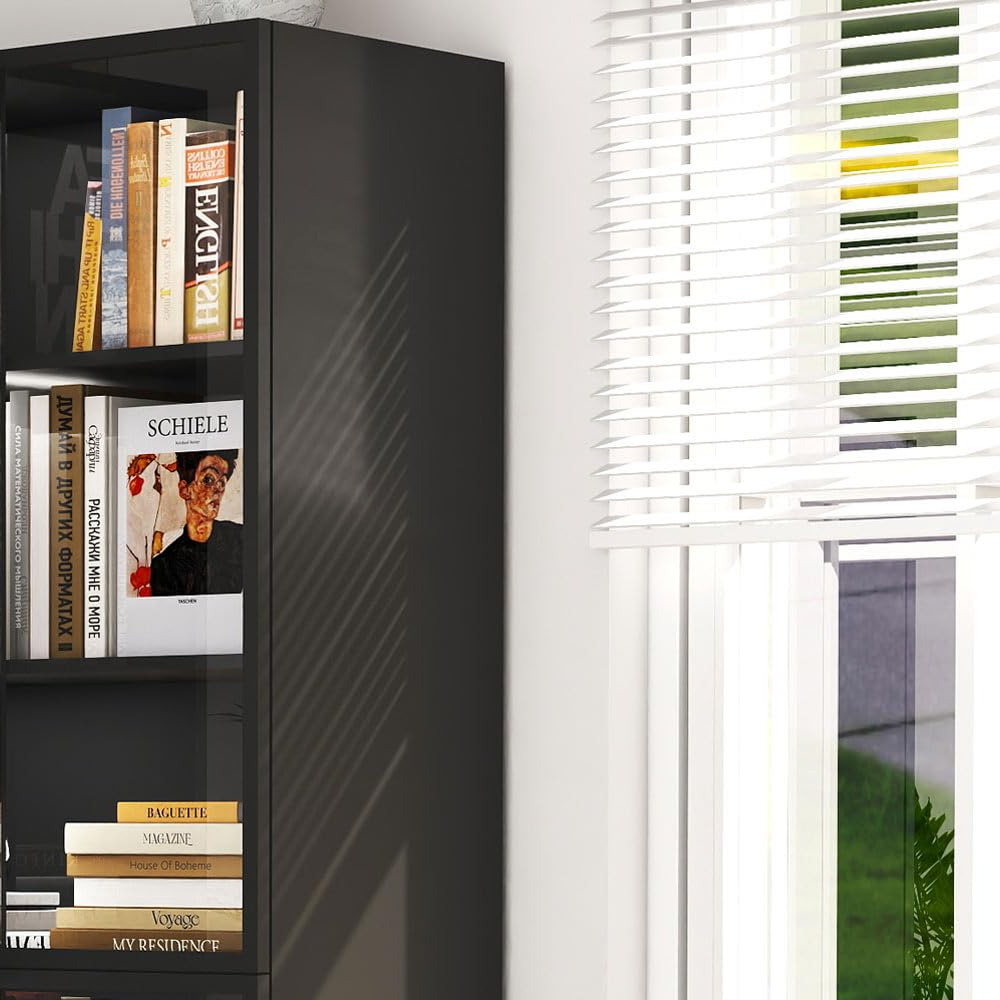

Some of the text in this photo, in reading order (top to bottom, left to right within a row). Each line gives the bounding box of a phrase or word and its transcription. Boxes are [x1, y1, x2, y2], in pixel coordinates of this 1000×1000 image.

[56, 395, 76, 455] ДУМАЙ
[147, 414, 229, 437] SCHIELE
[58, 460, 72, 471] В
[56, 477, 73, 541] ДРУГИХ
[14, 426, 22, 630] СИЛА МАТЕМАТИЧЕСКОГО МЫШЛЕНИЯ
[88, 498, 101, 639] РАССКАЖИ МНЕ О МОРЕ
[58, 547, 73, 636] ФОРМАТАХ
[147, 807, 207, 818] BAGUETTE
[143, 832, 193, 846] MAGAZINE
[130, 860, 212, 870] House Of Boheme
[152, 910, 200, 929] Voyage
[113, 938, 220, 952] MY RESIDENCE
